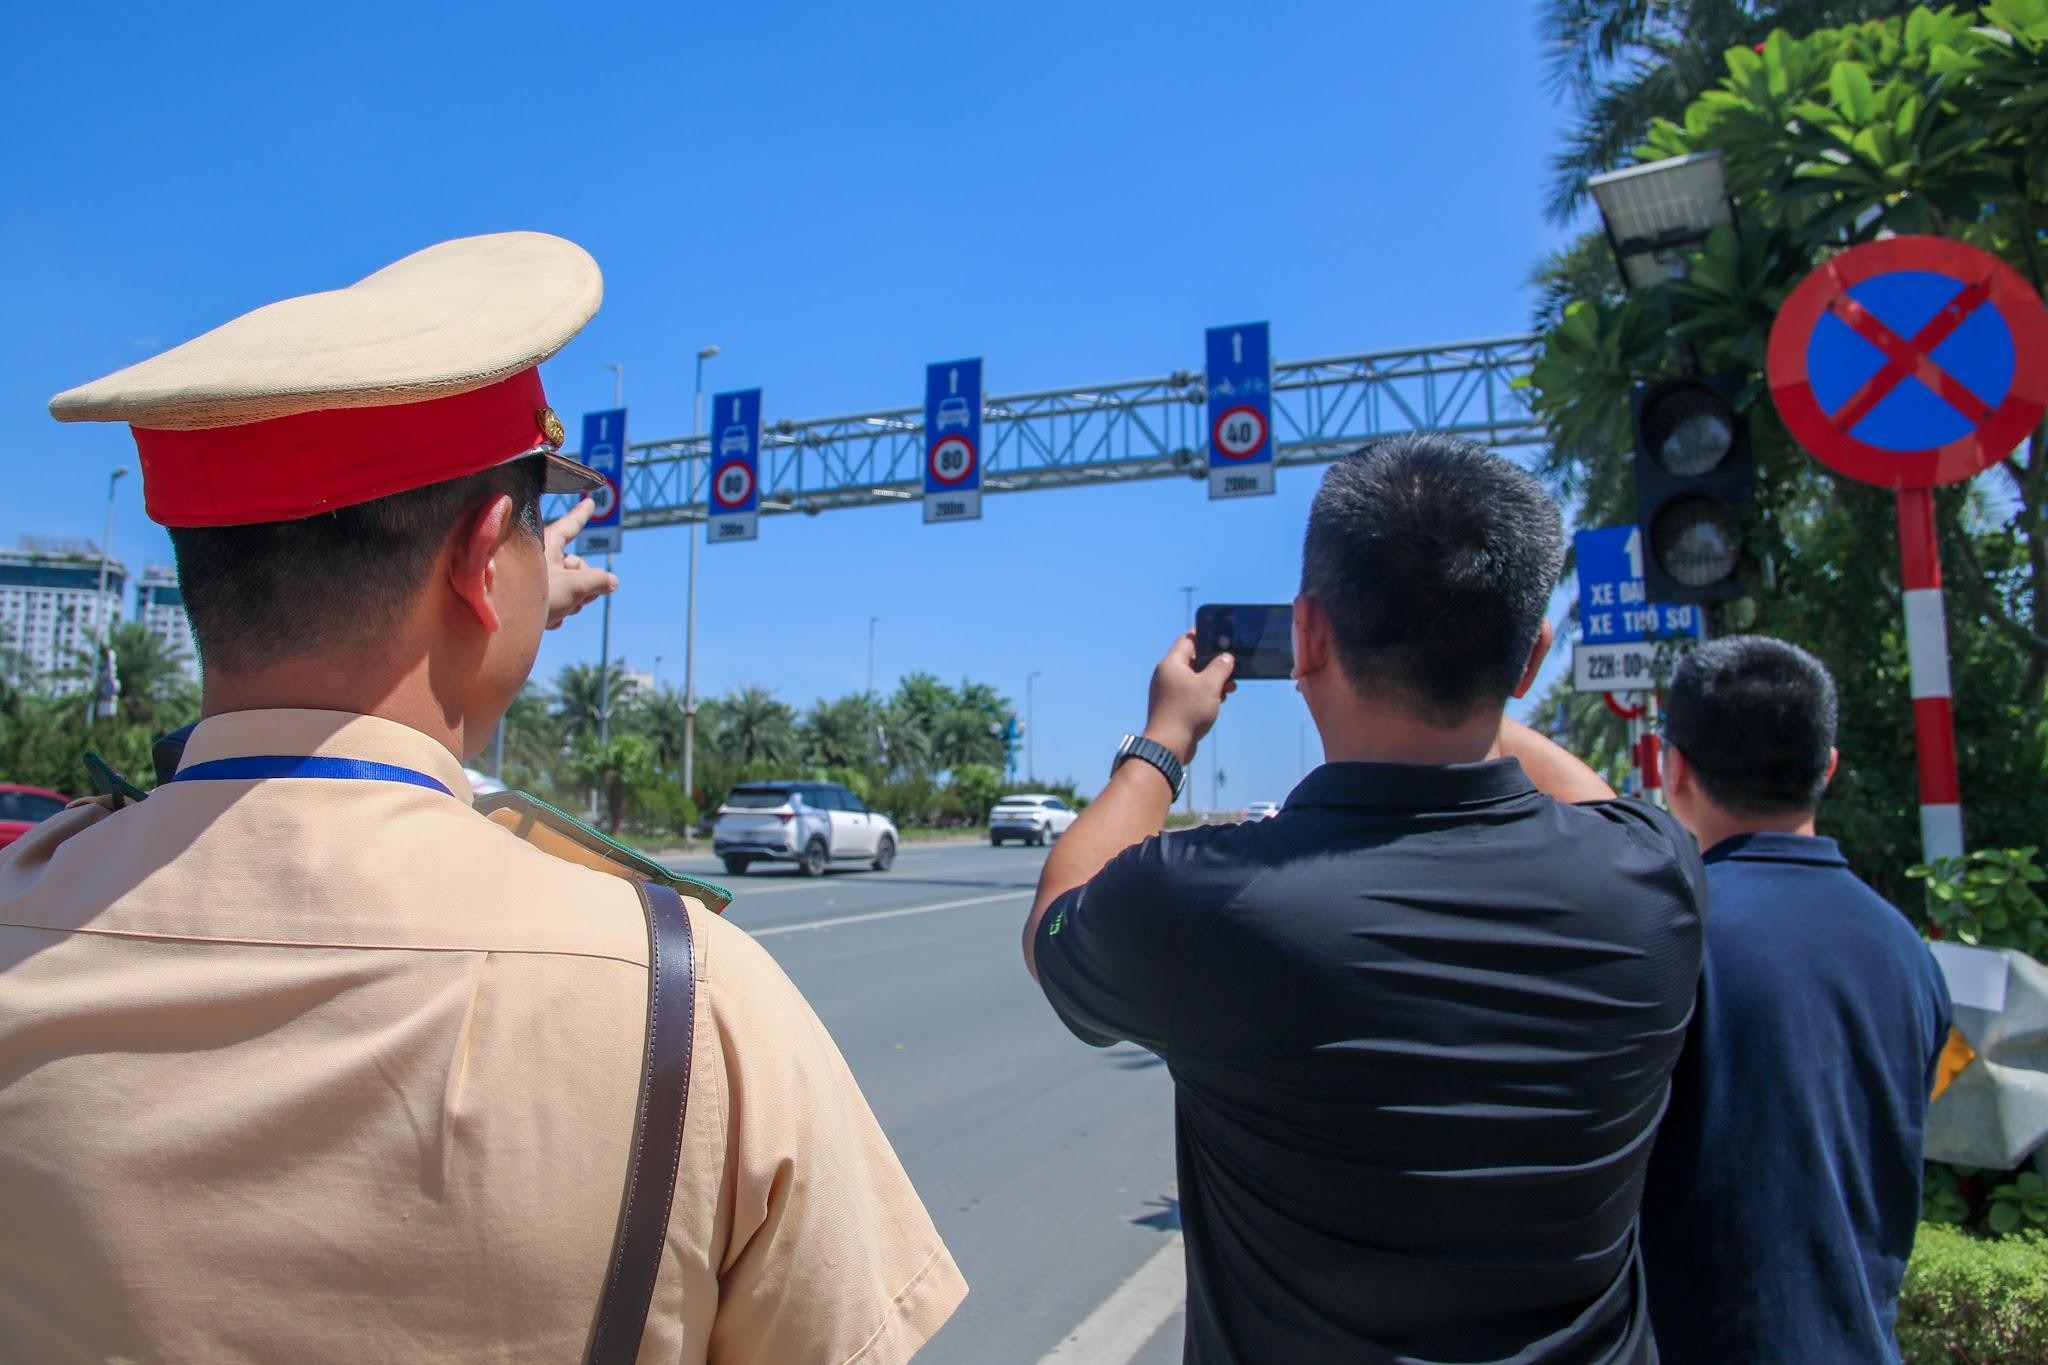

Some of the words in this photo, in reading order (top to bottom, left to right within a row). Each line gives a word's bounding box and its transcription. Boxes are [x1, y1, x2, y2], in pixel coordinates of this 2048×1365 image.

[1226, 421, 1251, 444] 40
[941, 449, 963, 471] 80
[723, 474, 743, 494] 80
[1224, 476, 1259, 493] 200m
[935, 502, 966, 517] 200m
[1590, 583, 1614, 606] XE
[1590, 612, 1614, 636] XE
